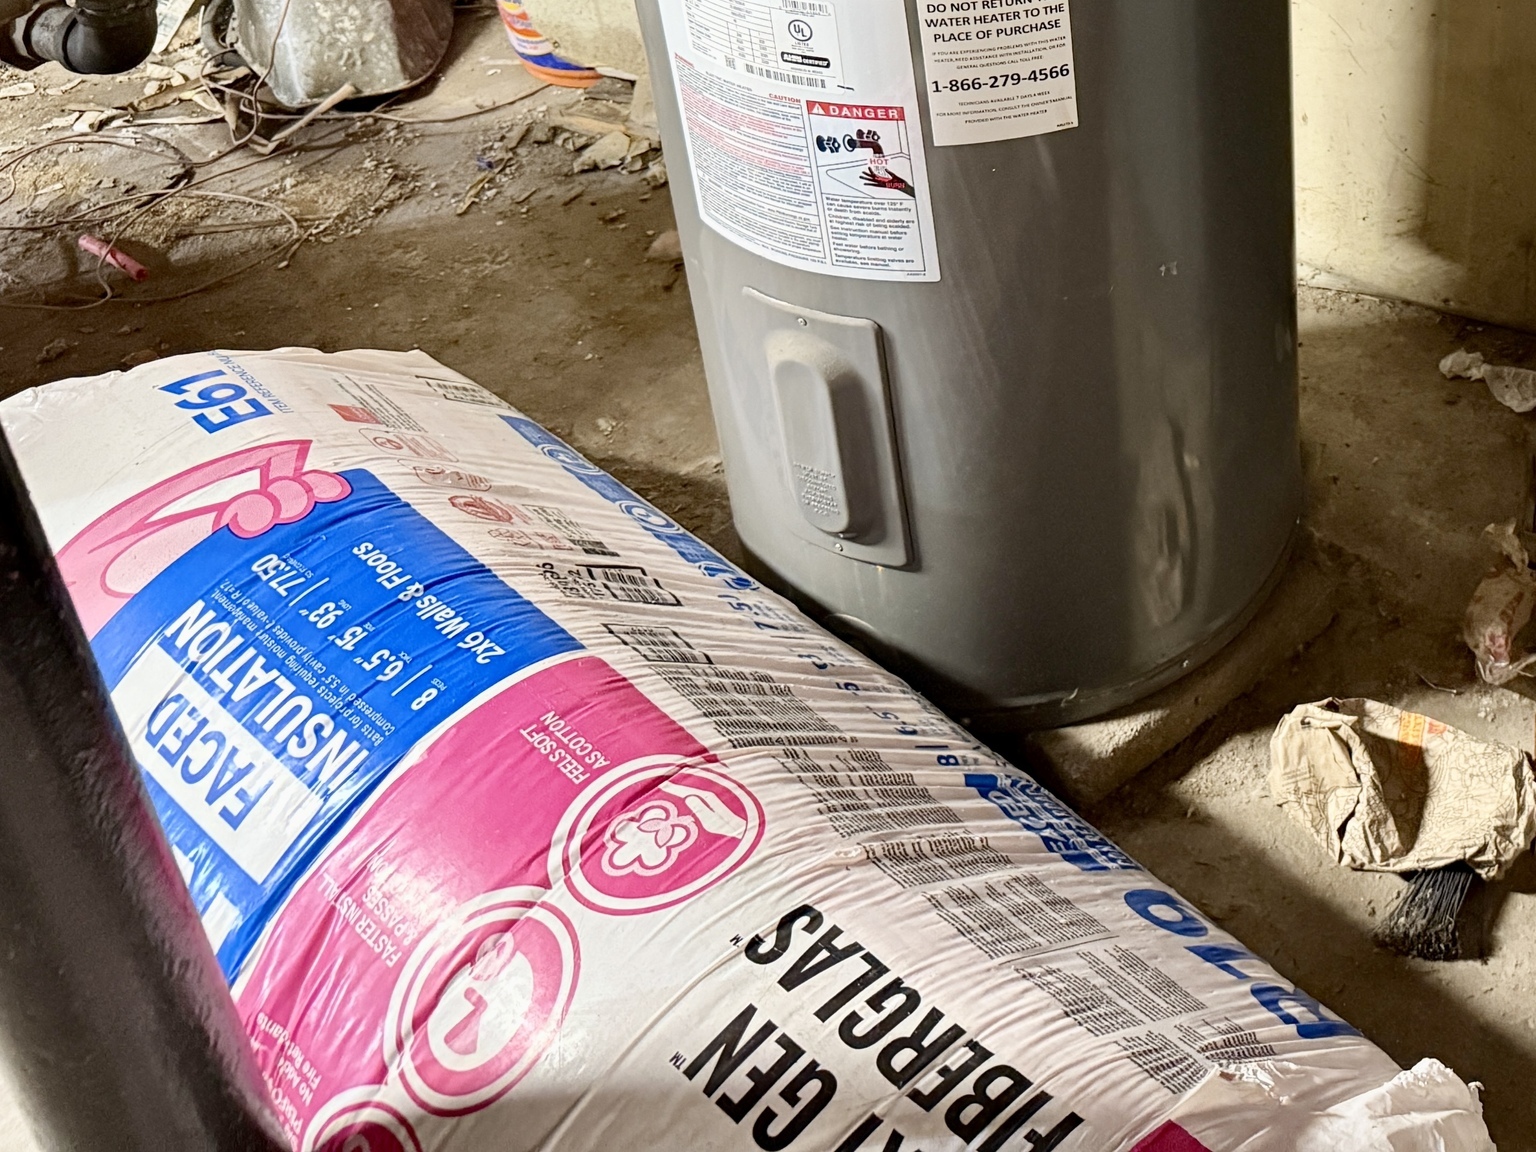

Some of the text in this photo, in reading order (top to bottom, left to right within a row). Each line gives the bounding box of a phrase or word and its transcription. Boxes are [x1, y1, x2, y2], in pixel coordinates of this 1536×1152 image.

[925, 3, 1065, 28] WATER HEATER TO THE
[927, 3, 946, 13] DO
[950, 1, 978, 12] NOT
[934, 19, 1061, 43] PLACE OF PURCHASE
[769, 93, 801, 103] CAUTION
[932, 64, 1070, 93] 1-866-279-4566
[830, 106, 899, 119] DANGER
[158, 369, 274, 434] E61
[228, 361, 294, 413] ITEM REFERENCE
[251, 554, 306, 597] 77.50
[352, 541, 412, 590] Floors
[398, 582, 424, 602] &
[415, 593, 471, 639] Walls
[164, 599, 370, 799] INSULATION
[272, 627, 396, 736] Compressed cavity provides
[285, 656, 384, 747] Batts projects requiring
[410, 688, 438, 711] 8
[145, 693, 275, 831] FACED
[519, 723, 592, 786] FEELS SOFT
[539, 710, 612, 771] AS COTTON
[357, 918, 403, 968] FASTER
[683, 1003, 838, 1152] GEN
